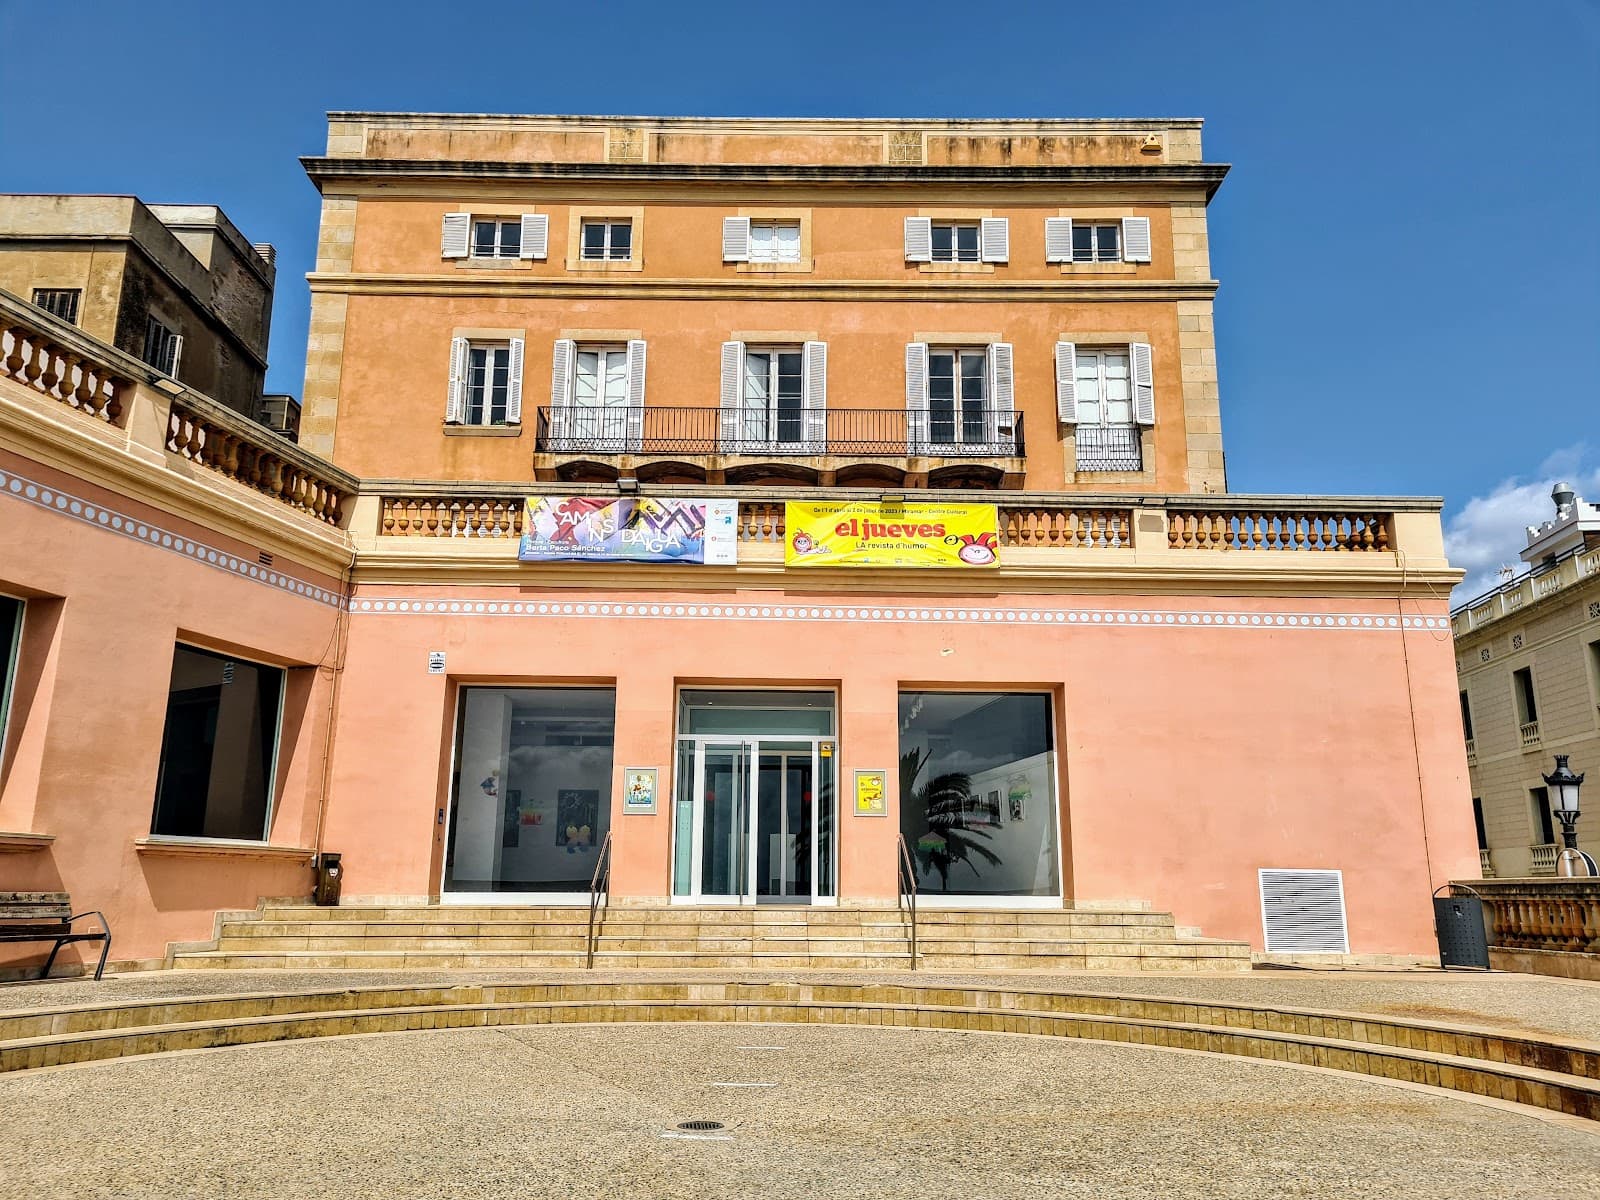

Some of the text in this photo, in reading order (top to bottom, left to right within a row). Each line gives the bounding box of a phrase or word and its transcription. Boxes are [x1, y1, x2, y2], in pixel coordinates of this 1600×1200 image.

[835, 518, 946, 541] el jueves
[526, 543, 605, 552] Berta Paco Sánchez
[855, 541, 866, 549] LA
[895, 542, 928, 550] d'humor
